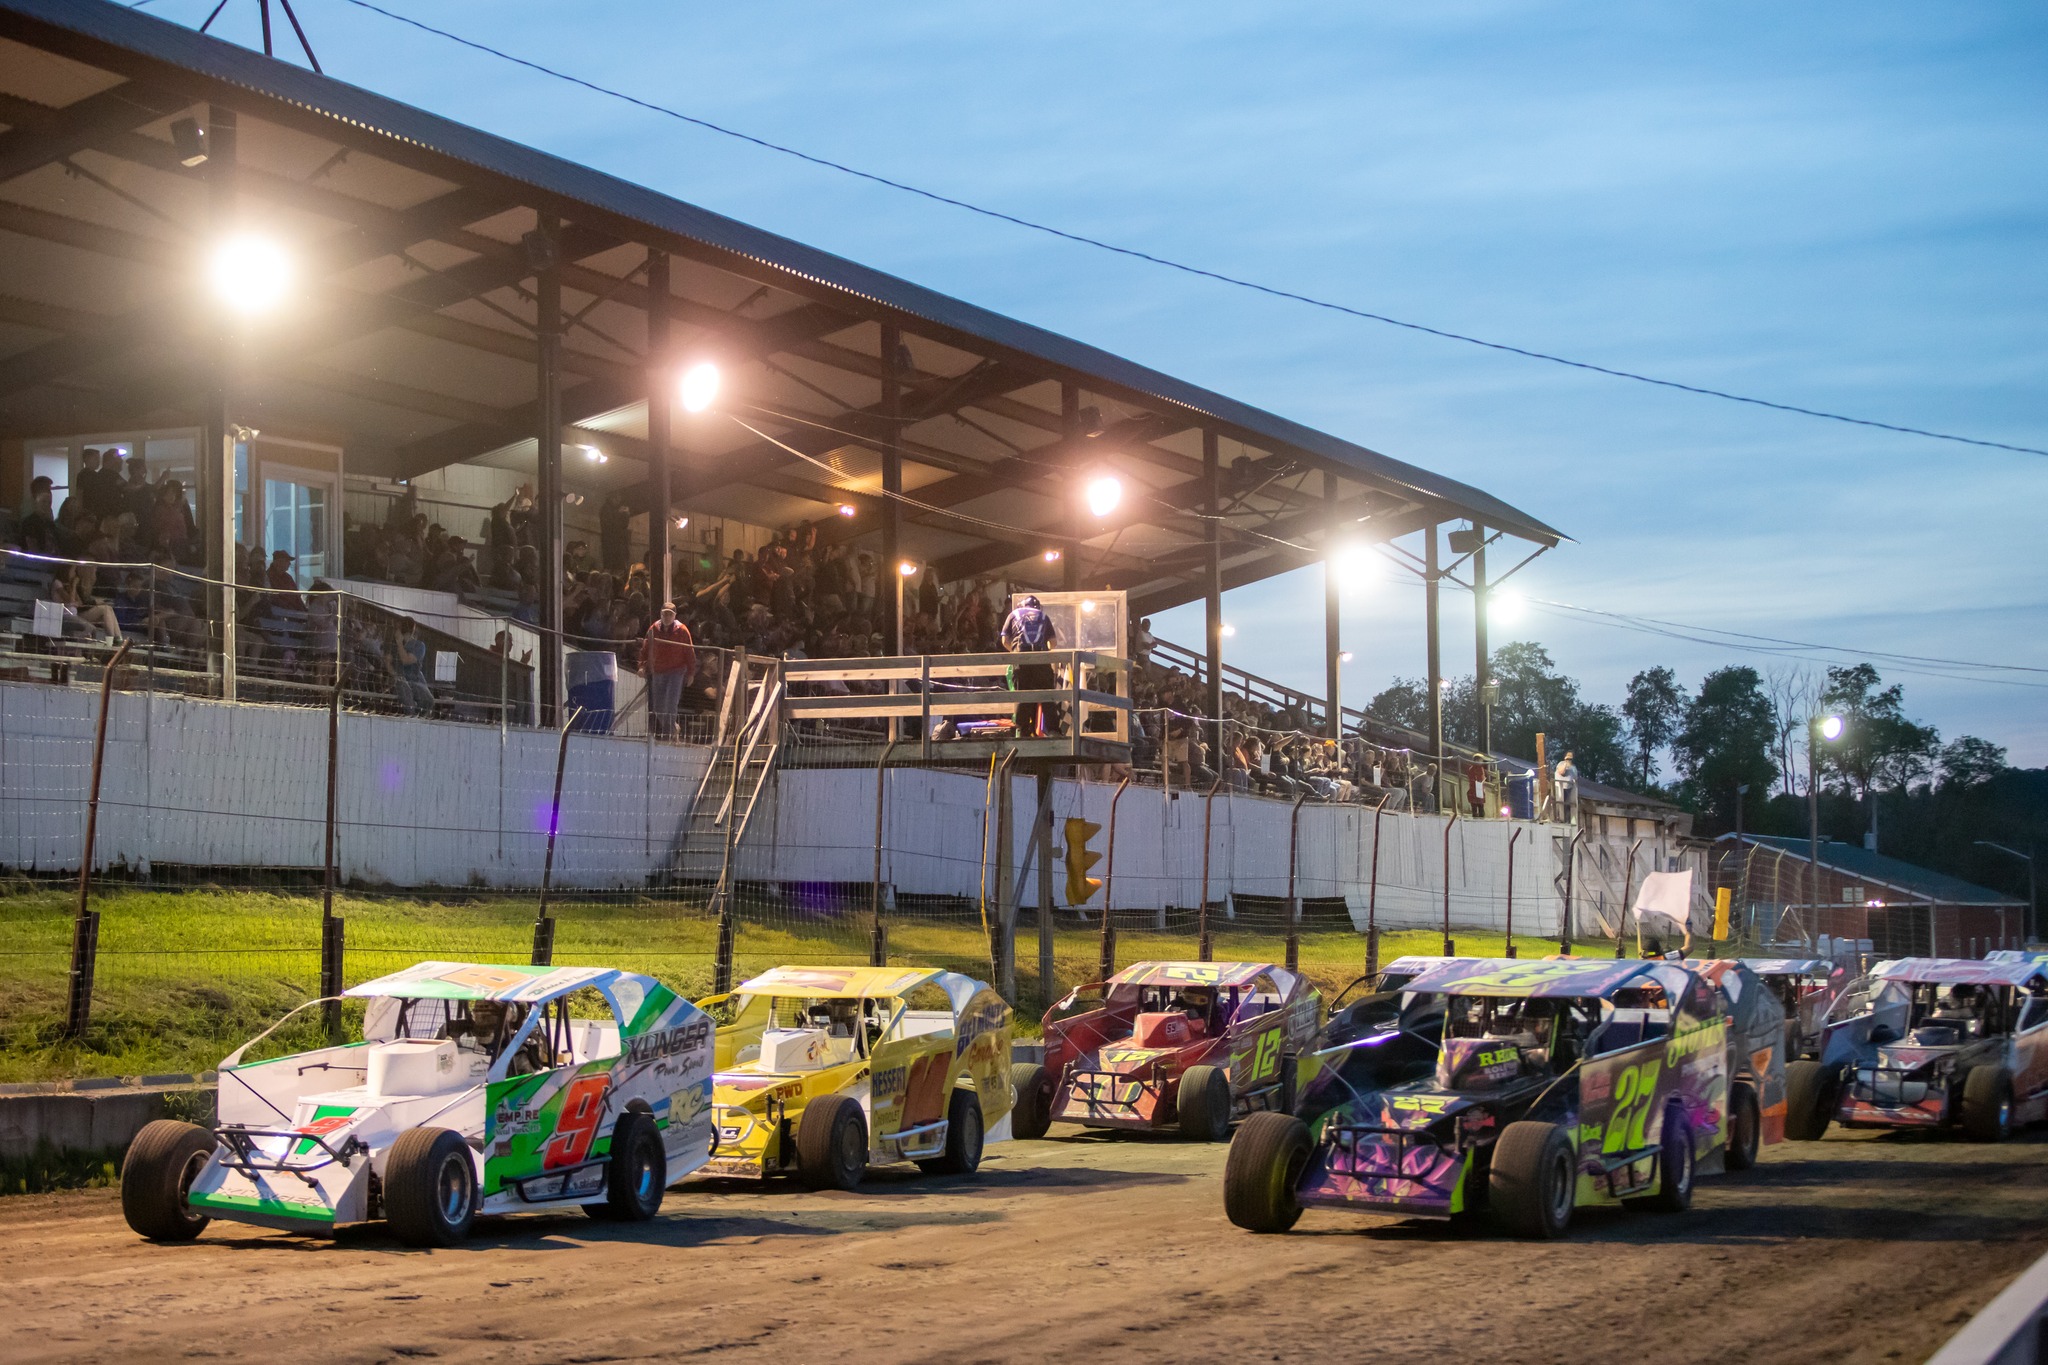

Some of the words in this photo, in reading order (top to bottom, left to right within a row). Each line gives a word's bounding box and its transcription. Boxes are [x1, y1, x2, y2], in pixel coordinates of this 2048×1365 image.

[1251, 1027, 1282, 1082] 12
[775, 1082, 803, 1100] PWD
[1601, 1062, 1661, 1154] 27
